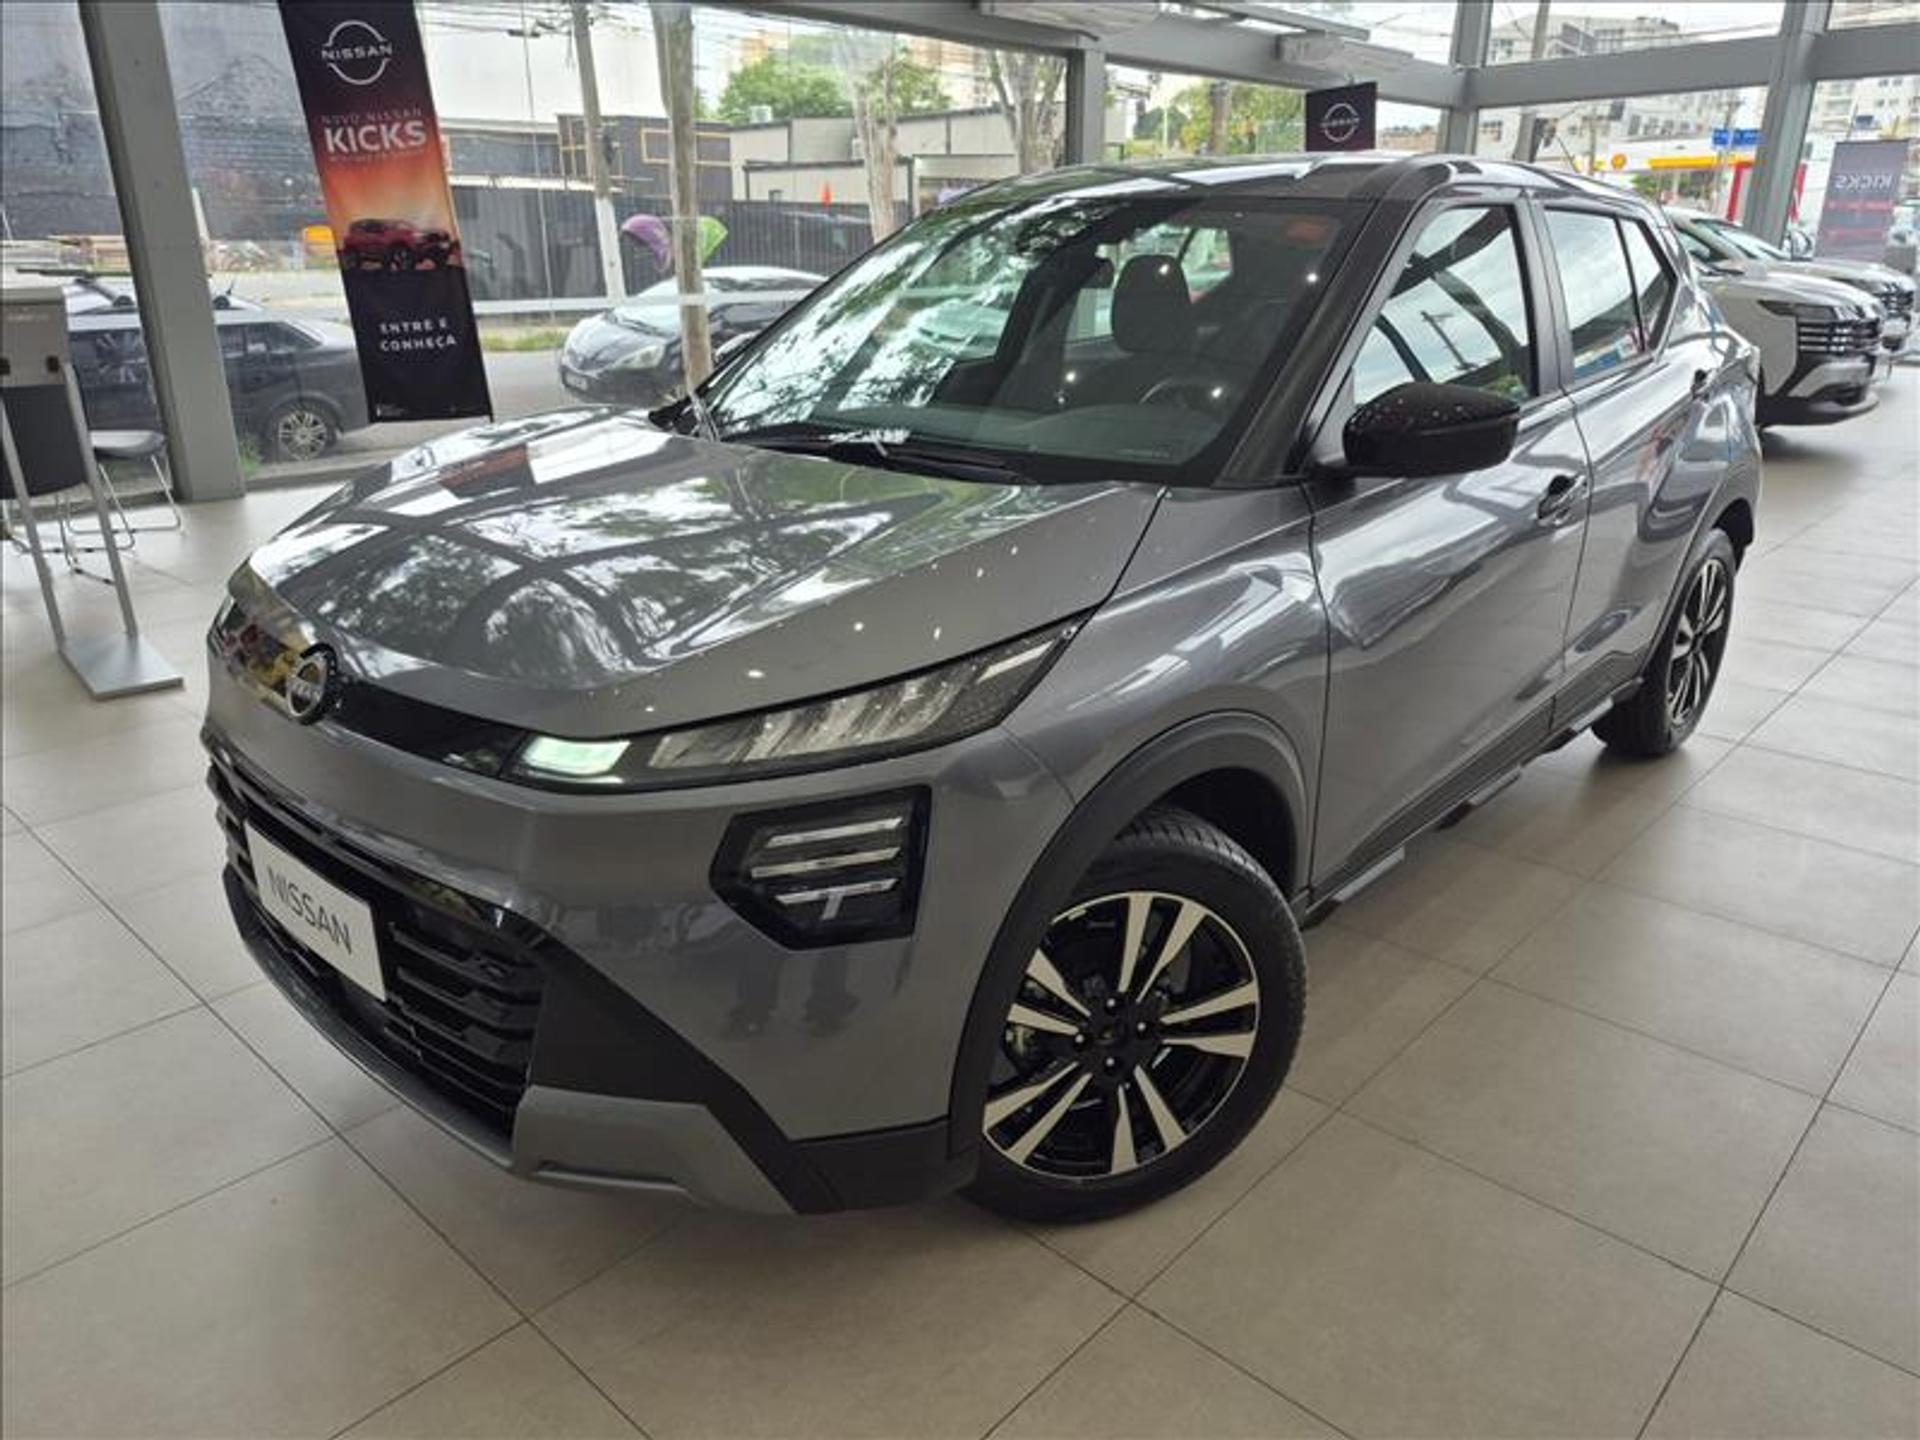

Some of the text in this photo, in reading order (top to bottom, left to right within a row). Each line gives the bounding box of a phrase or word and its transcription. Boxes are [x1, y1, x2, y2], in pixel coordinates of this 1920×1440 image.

[321, 45, 393, 59] NISSAN
[323, 120, 427, 153] KICKS
[380, 317, 448, 334] ENTRE E
[380, 334, 457, 351] CONHEÇA
[267, 864, 352, 955] NISSAN
